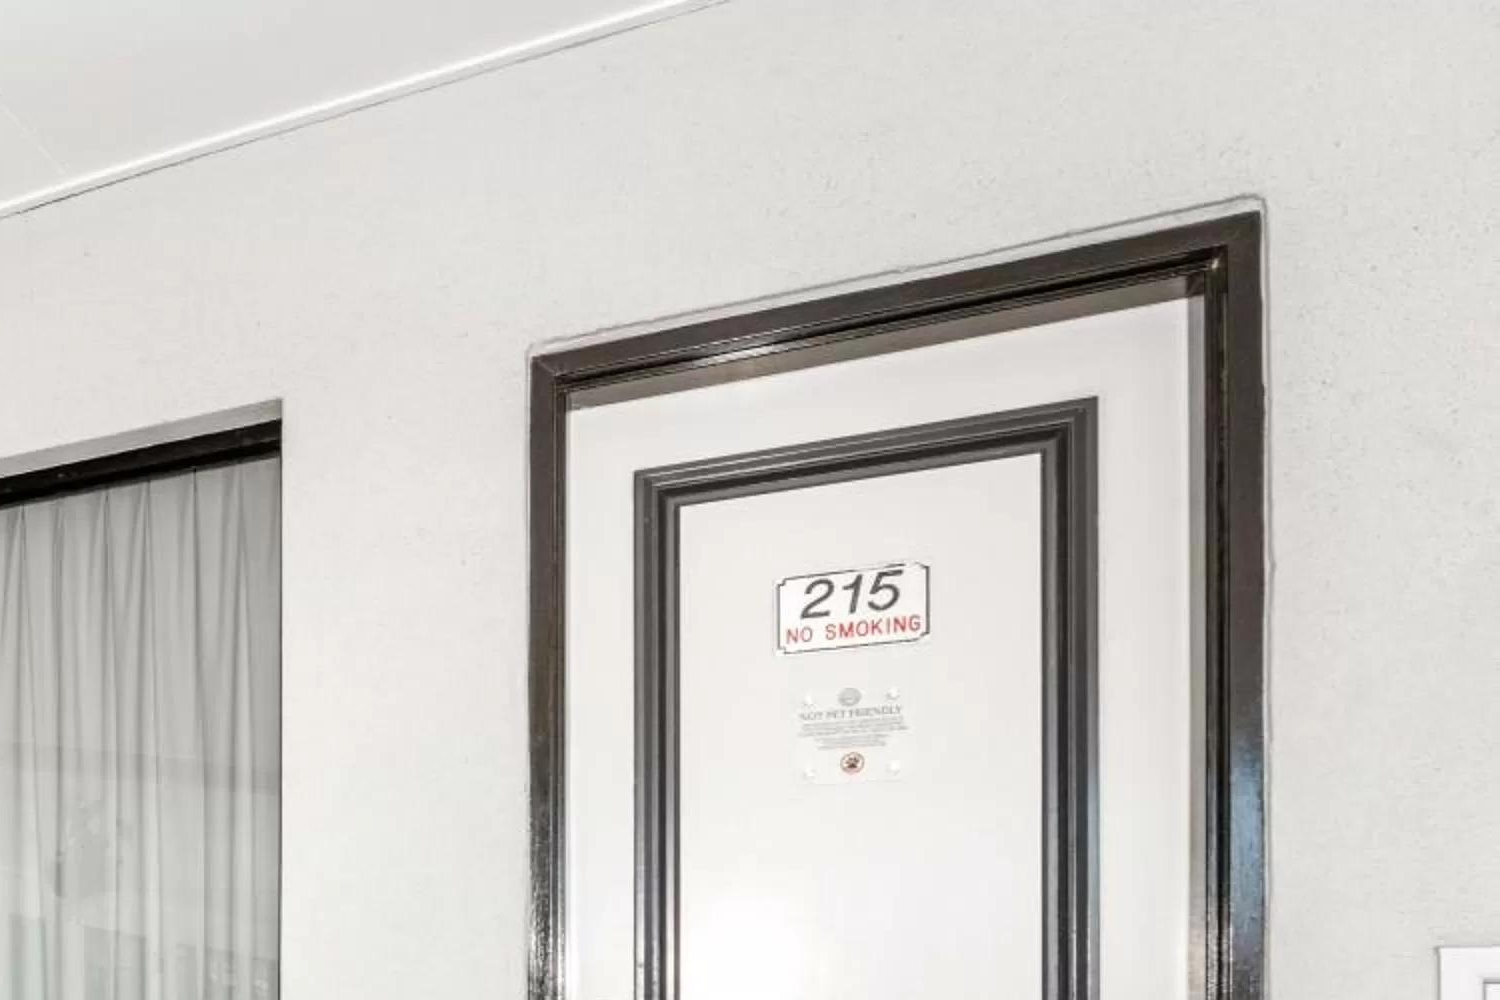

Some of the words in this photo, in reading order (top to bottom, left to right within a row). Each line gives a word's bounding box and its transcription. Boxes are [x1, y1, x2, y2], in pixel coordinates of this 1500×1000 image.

[800, 569, 904, 619] 215
[786, 626, 813, 644] NO
[825, 614, 922, 640] SMOKING
